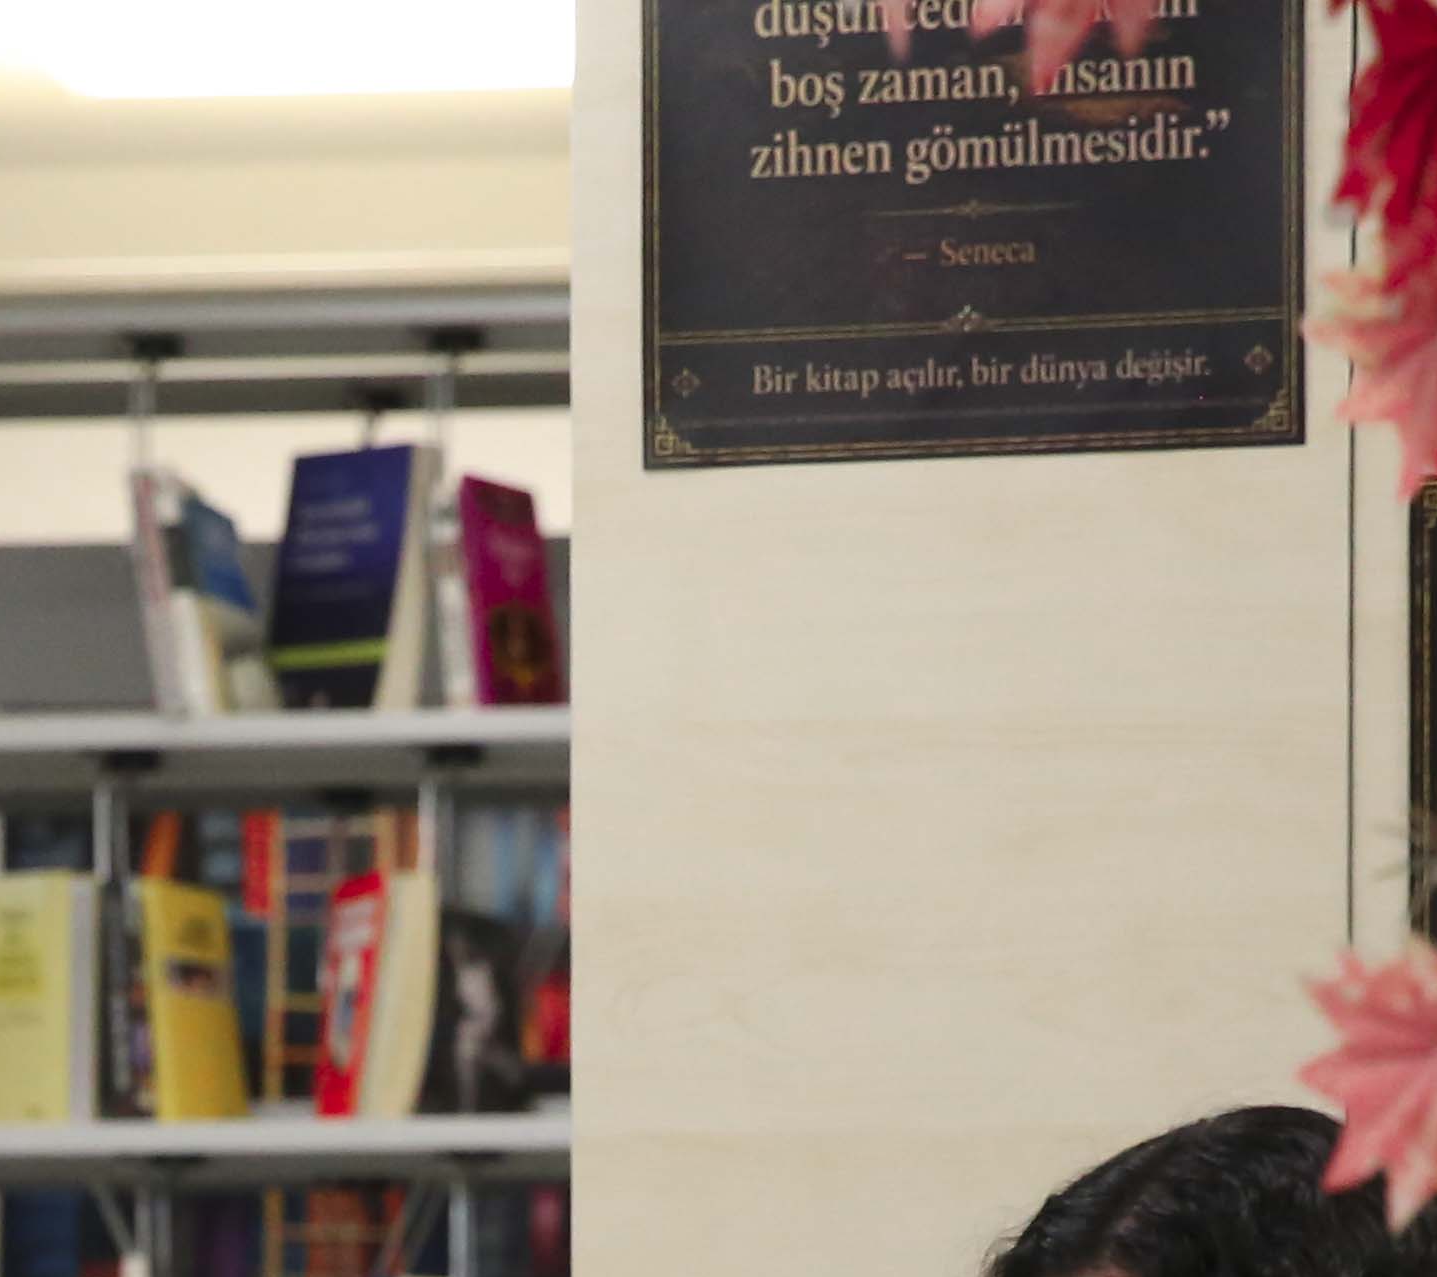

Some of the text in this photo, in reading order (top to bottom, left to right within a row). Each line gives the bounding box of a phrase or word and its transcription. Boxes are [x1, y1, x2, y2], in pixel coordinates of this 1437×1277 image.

[768, 53, 1196, 118] boş zaman, nsanın
[749, 109, 1232, 185] zihnen gömülmesidir.”
[939, 239, 1037, 267] Seneca
[752, 365, 799, 396] Bir
[805, 362, 880, 399] kitap
[972, 356, 1015, 385] bir
[1019, 353, 1109, 391] dünya
[1115, 348, 1214, 385] değişir.
